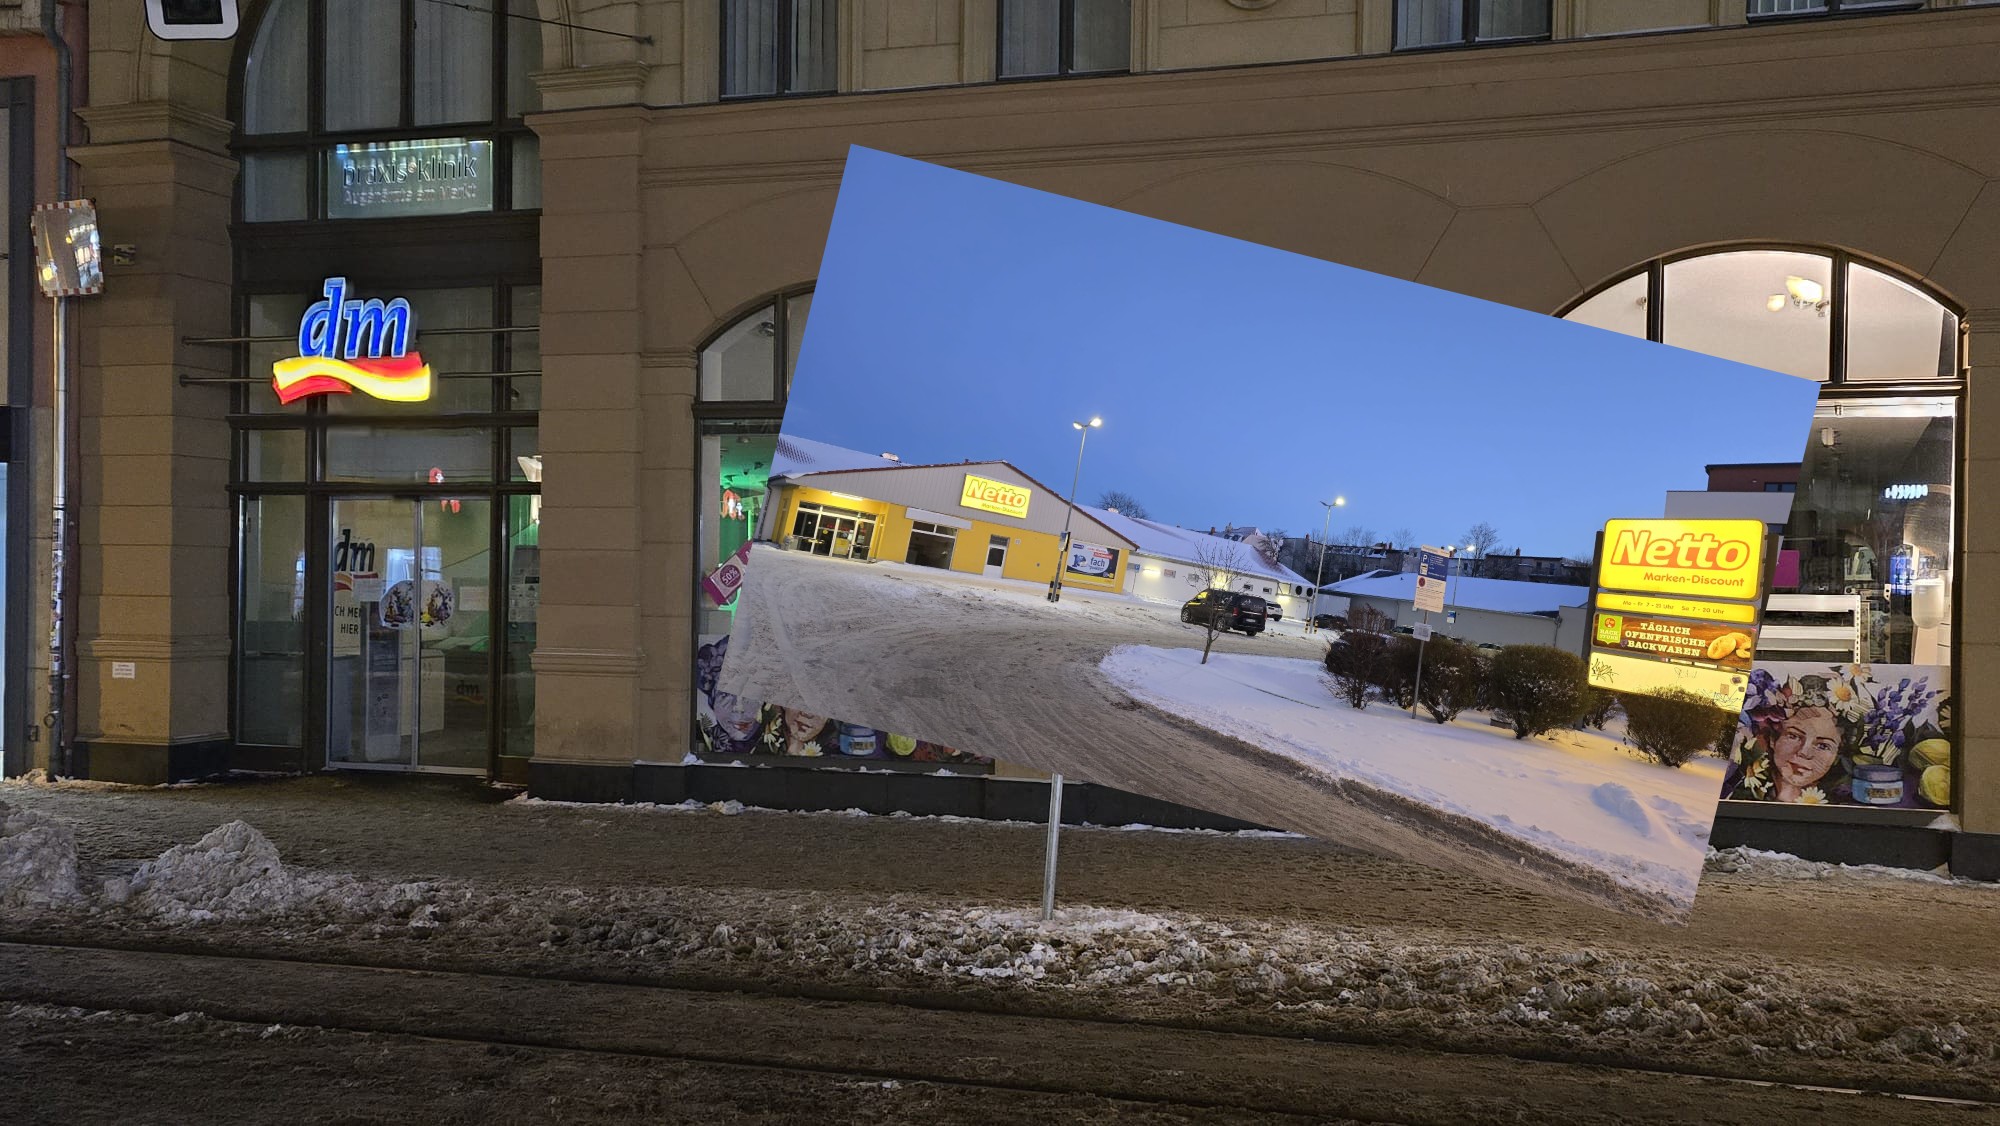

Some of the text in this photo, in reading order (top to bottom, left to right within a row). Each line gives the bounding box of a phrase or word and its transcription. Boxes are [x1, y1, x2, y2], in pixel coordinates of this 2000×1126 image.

[298, 277, 411, 359] dm
[966, 479, 1027, 508] Netto
[334, 529, 375, 572] dm
[1610, 529, 1750, 571] Netto
[1090, 557, 1106, 568] fach
[722, 567, 738, 584] 50%
[1643, 572, 1744, 587] Marken-Discount
[340, 623, 359, 635] HIER
[1640, 622, 1691, 636] TÄGLICH
[1625, 630, 1706, 648] OFENFRISCHE
[1627, 639, 1701, 657] BACKWAREN
